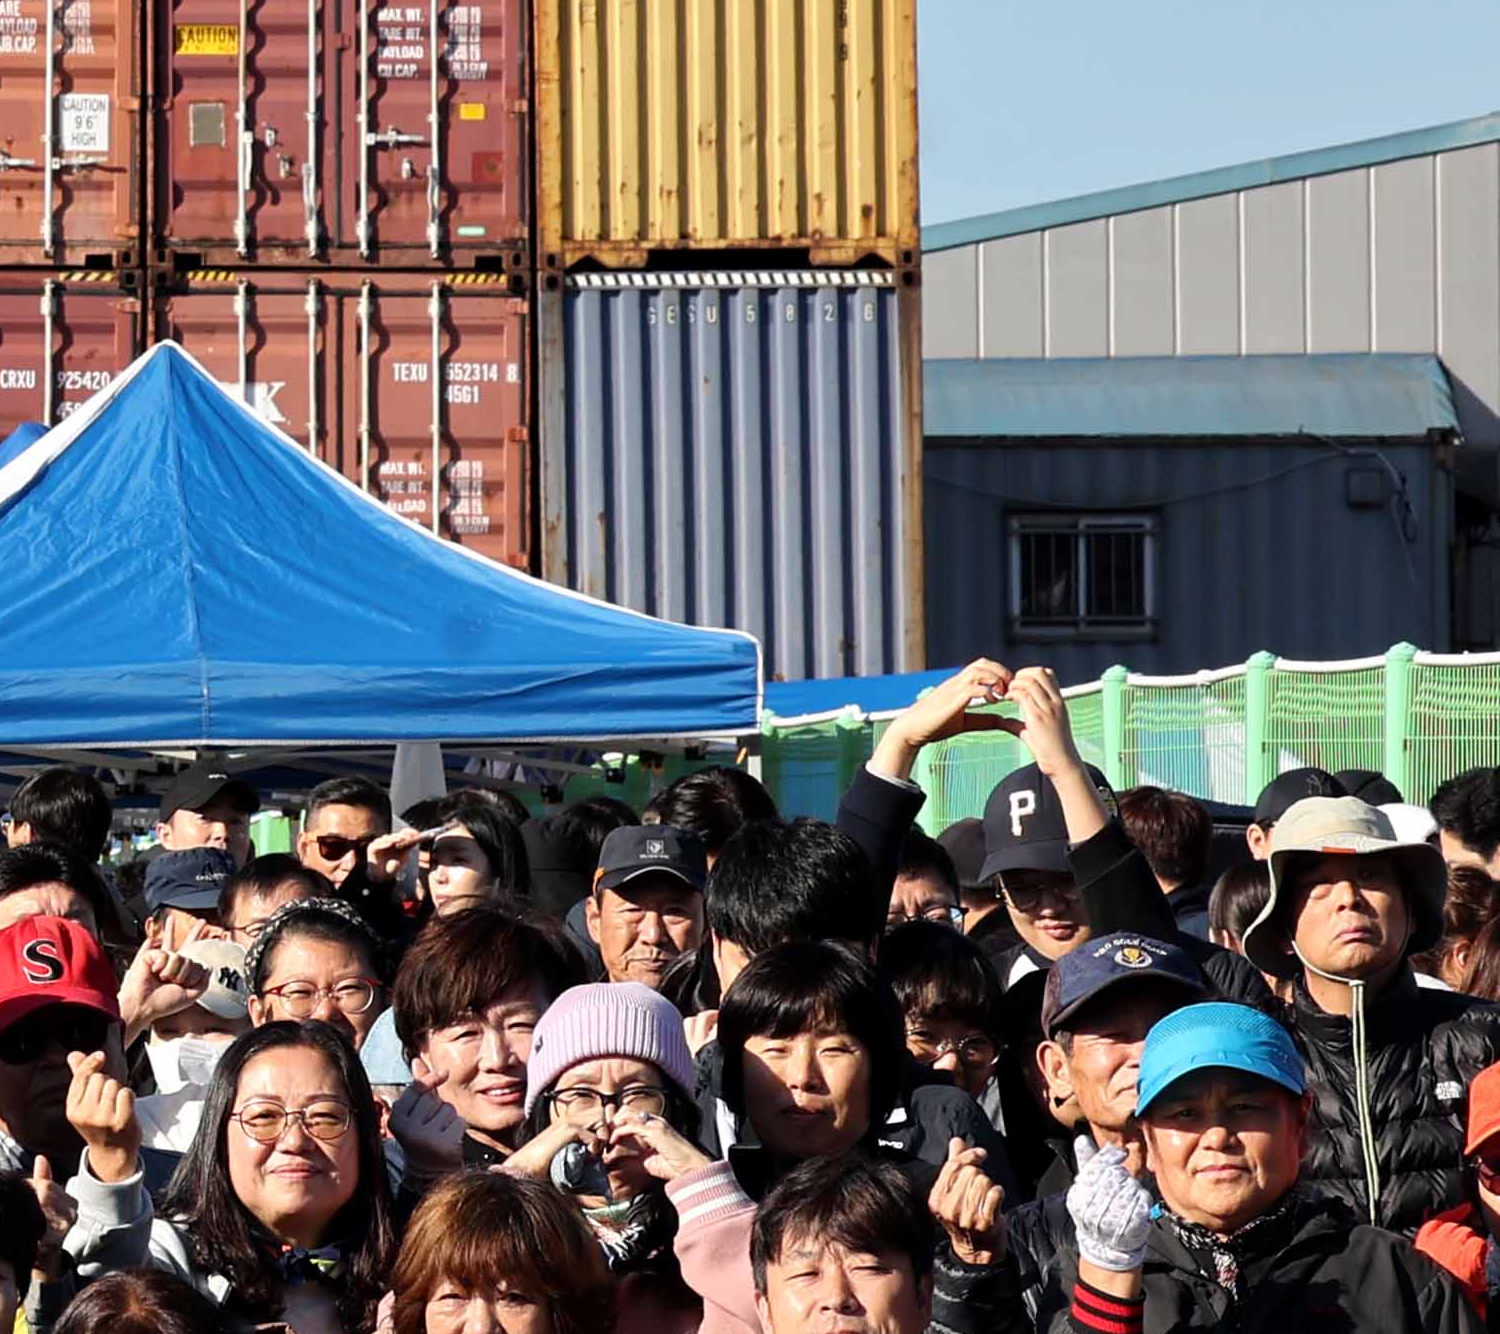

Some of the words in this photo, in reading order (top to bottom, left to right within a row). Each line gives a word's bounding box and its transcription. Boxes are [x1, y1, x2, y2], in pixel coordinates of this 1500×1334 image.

[177, 25, 238, 45] CAUTION
[61, 97, 107, 113] CAUTION
[70, 134, 98, 148] HIGH
[0, 368, 36, 389] CRXU
[393, 363, 429, 383] TEXU
[1008, 789, 1038, 838] P
[22, 938, 65, 984] S
